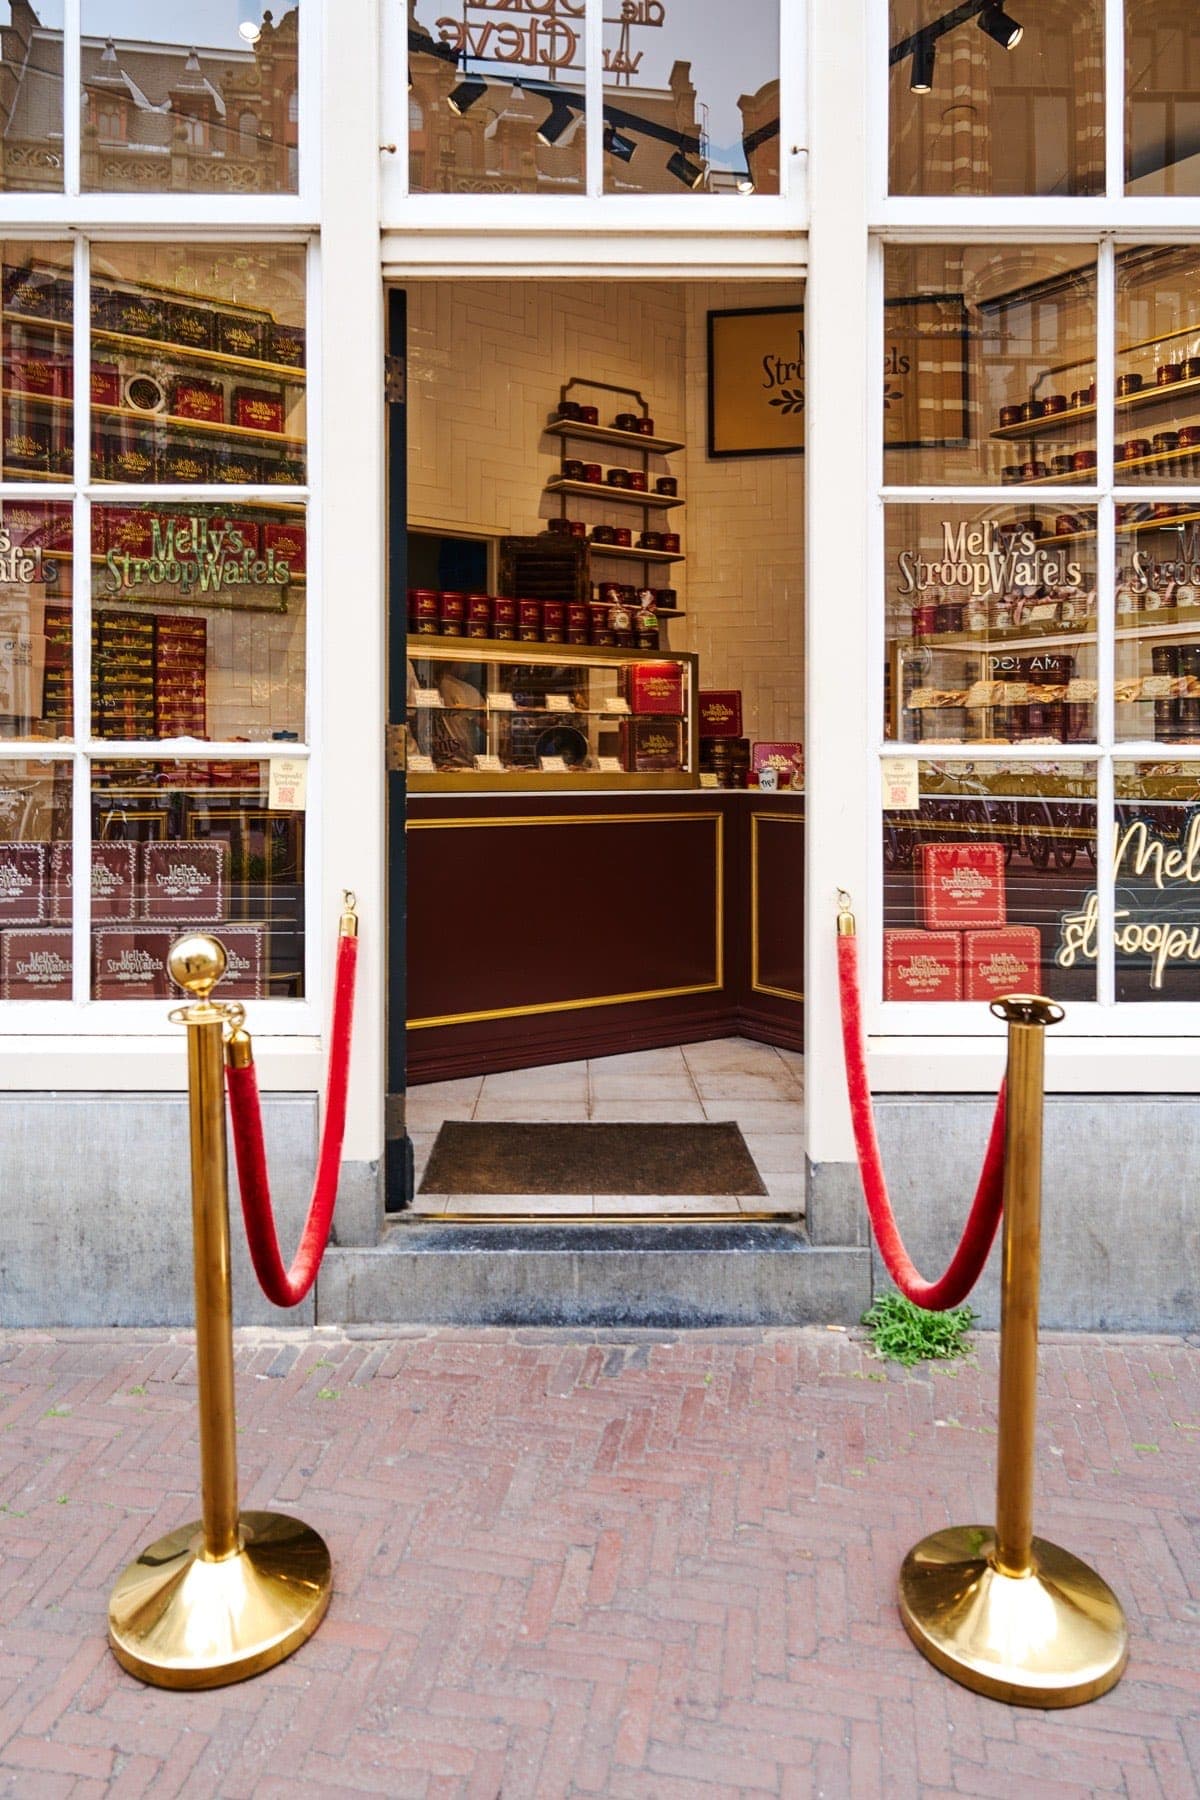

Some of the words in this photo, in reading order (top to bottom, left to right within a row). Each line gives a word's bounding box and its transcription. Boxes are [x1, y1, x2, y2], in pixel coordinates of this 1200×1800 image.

[151, 517, 243, 562] Melly's
[942, 520, 1035, 563] Melly's
[105, 547, 290, 594] StroopWafels
[897, 550, 1082, 596] StroopWafels
